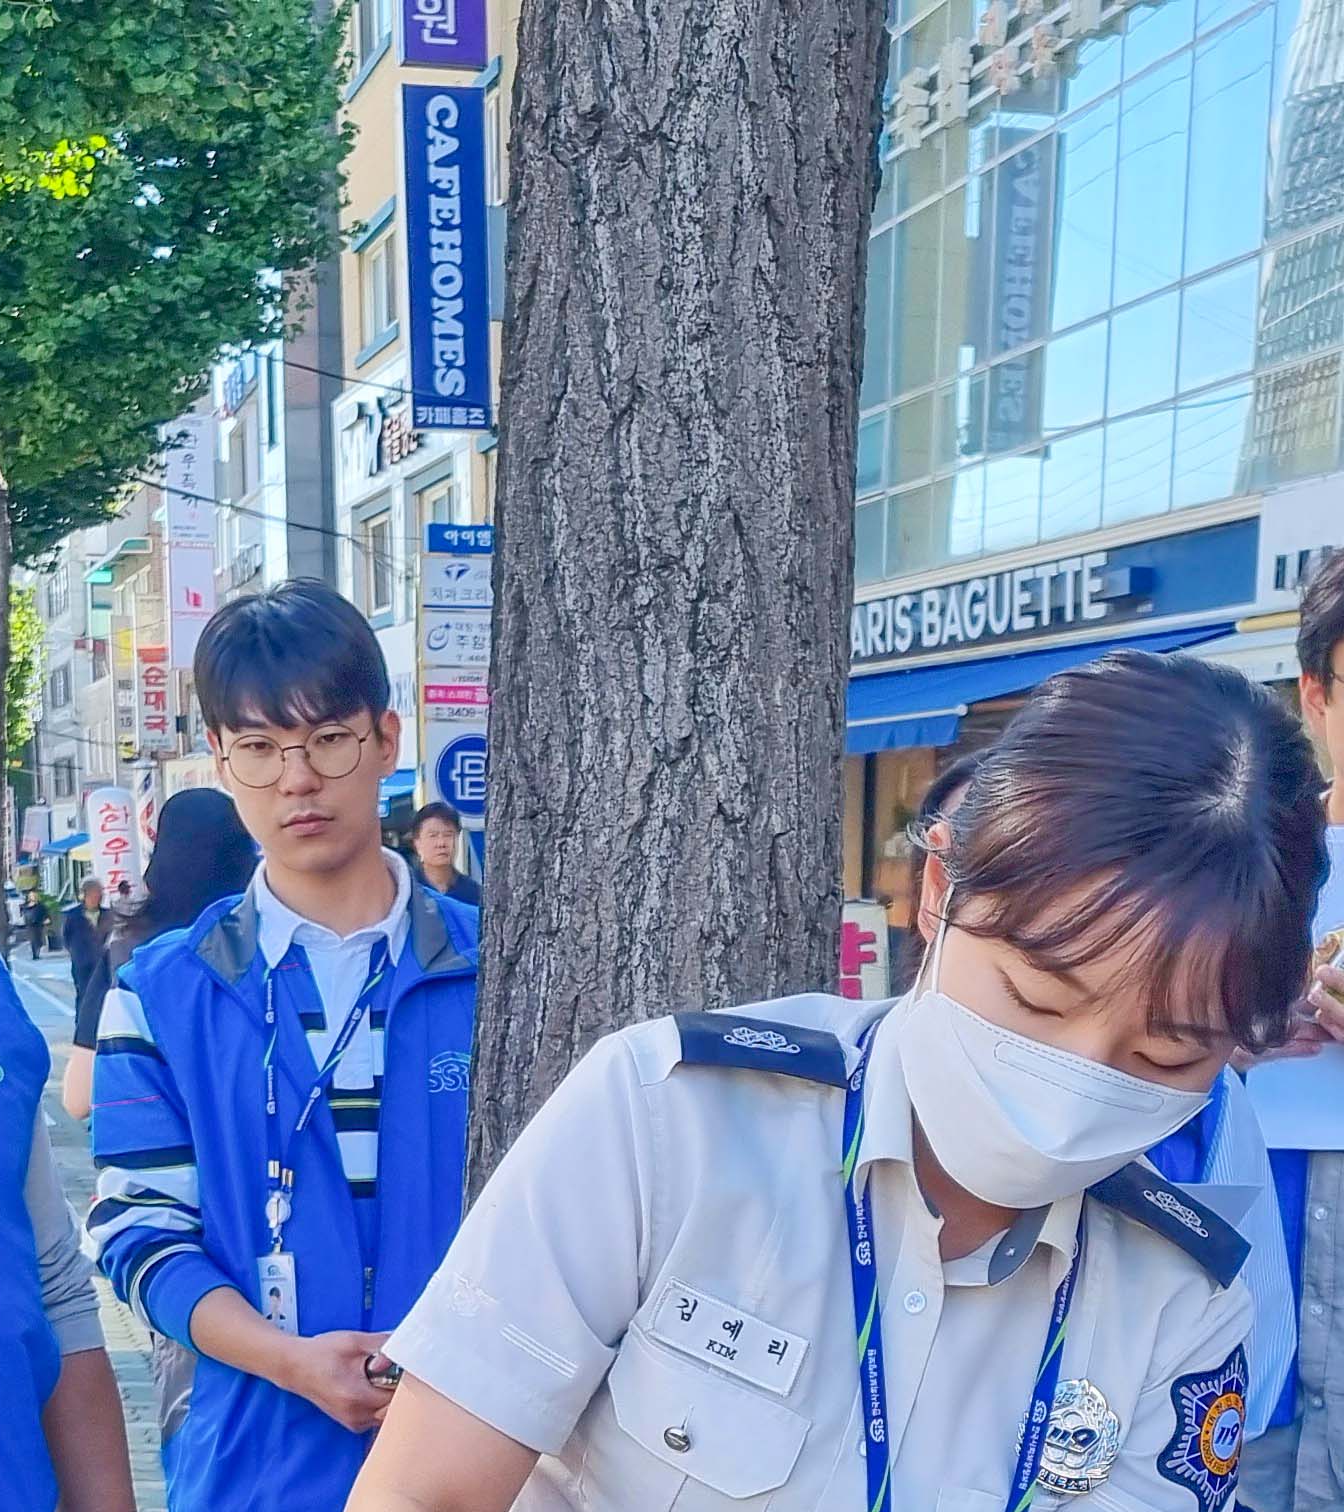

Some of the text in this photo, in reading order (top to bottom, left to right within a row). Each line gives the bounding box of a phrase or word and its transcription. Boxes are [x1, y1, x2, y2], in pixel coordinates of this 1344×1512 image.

[424, 93, 467, 398] CAFEHOMES
[849, 551, 1109, 659] ARIS BAGUETTE
[706, 1339, 739, 1361] KIM
[1214, 1423, 1240, 1446] 119
